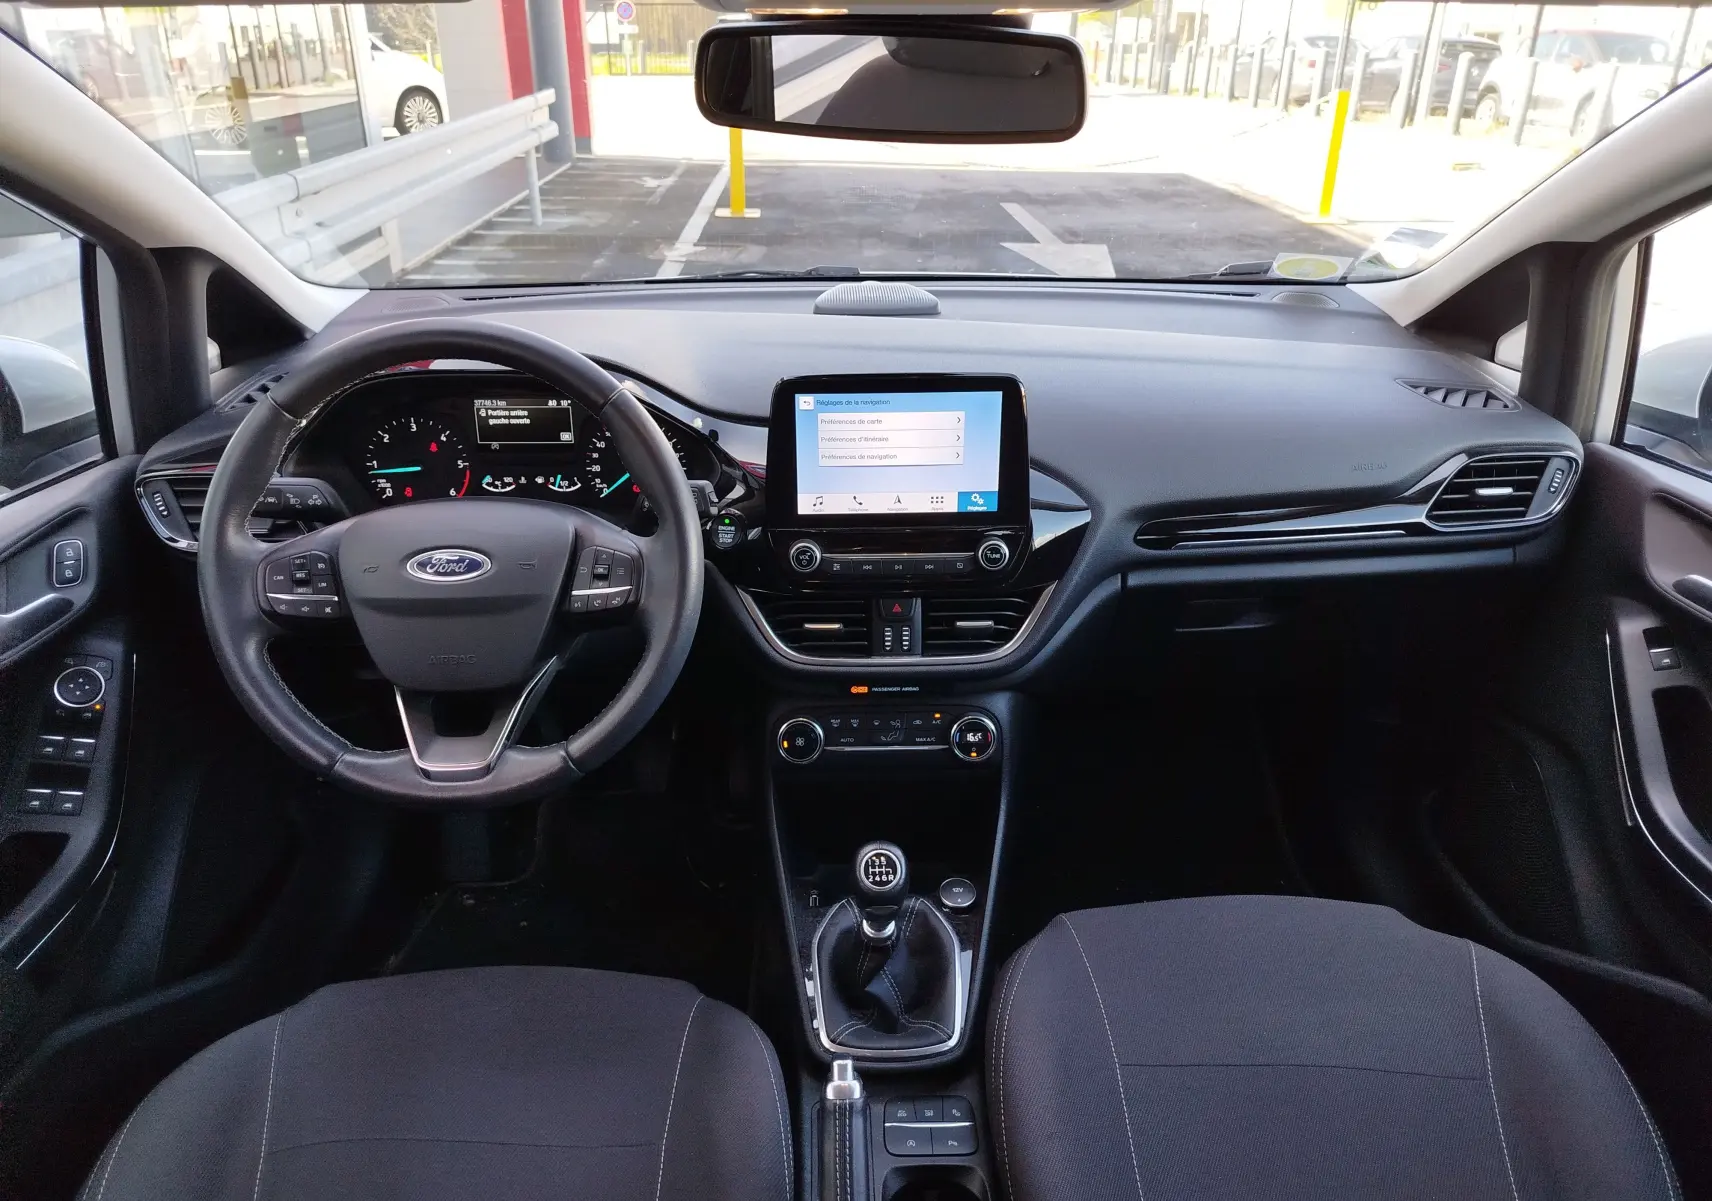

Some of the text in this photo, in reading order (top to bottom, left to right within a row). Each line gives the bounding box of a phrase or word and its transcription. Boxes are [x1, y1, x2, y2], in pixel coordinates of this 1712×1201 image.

[816, 399, 844, 407] Réglages
[860, 398, 891, 406] navigation
[410, 423, 417, 432] 3
[383, 434, 390, 442] 2
[440, 434, 447, 442] 4
[457, 460, 463, 468] 5
[386, 488, 392, 496] 0
[450, 488, 456, 496] 6
[426, 554, 470, 573] Ford
